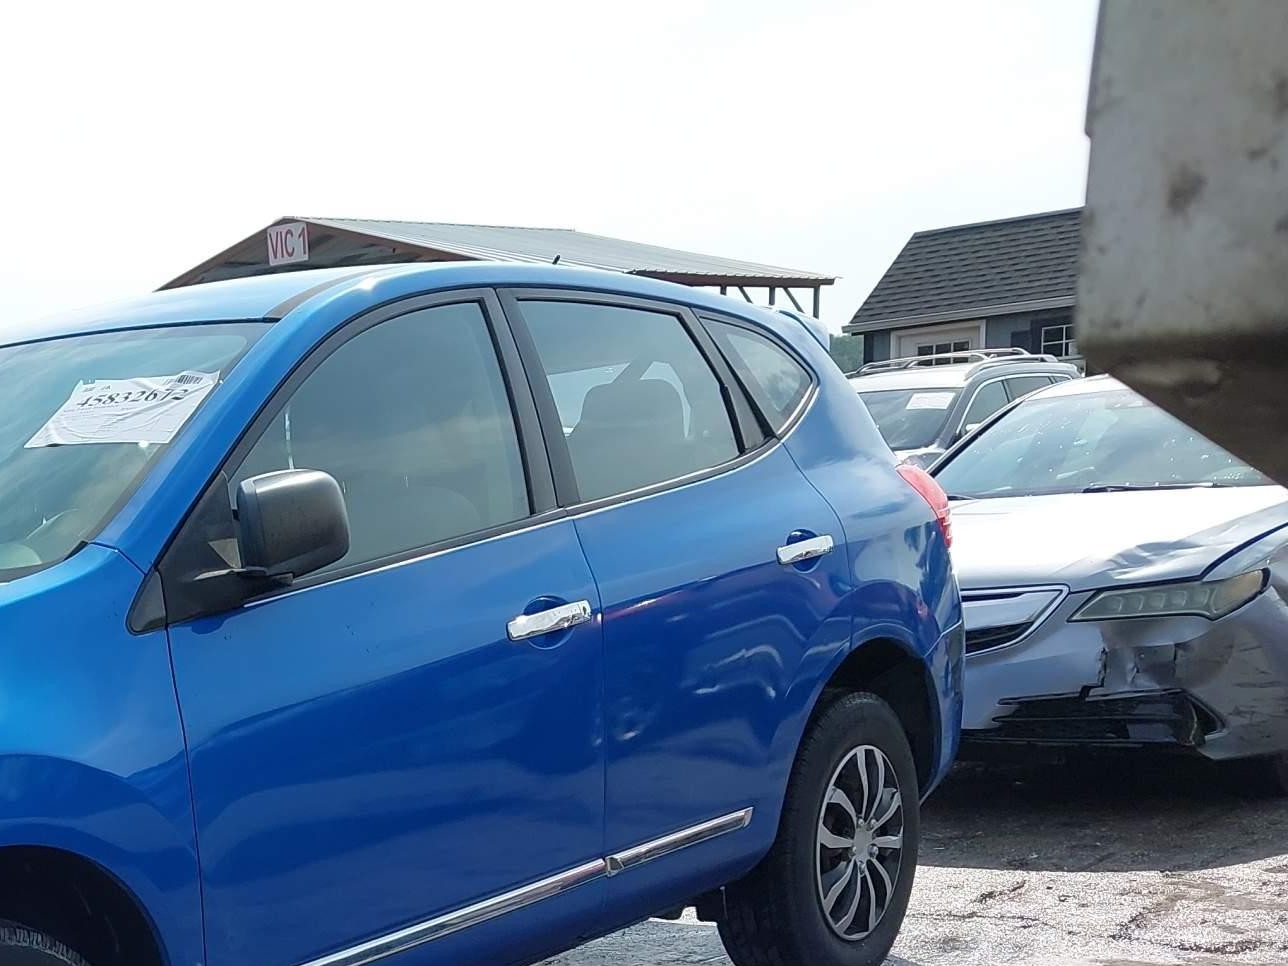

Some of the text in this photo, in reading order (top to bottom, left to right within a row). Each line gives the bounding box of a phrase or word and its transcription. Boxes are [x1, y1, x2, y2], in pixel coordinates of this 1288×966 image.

[268, 227, 306, 259] VIC 1
[77, 388, 189, 408] 45832672
